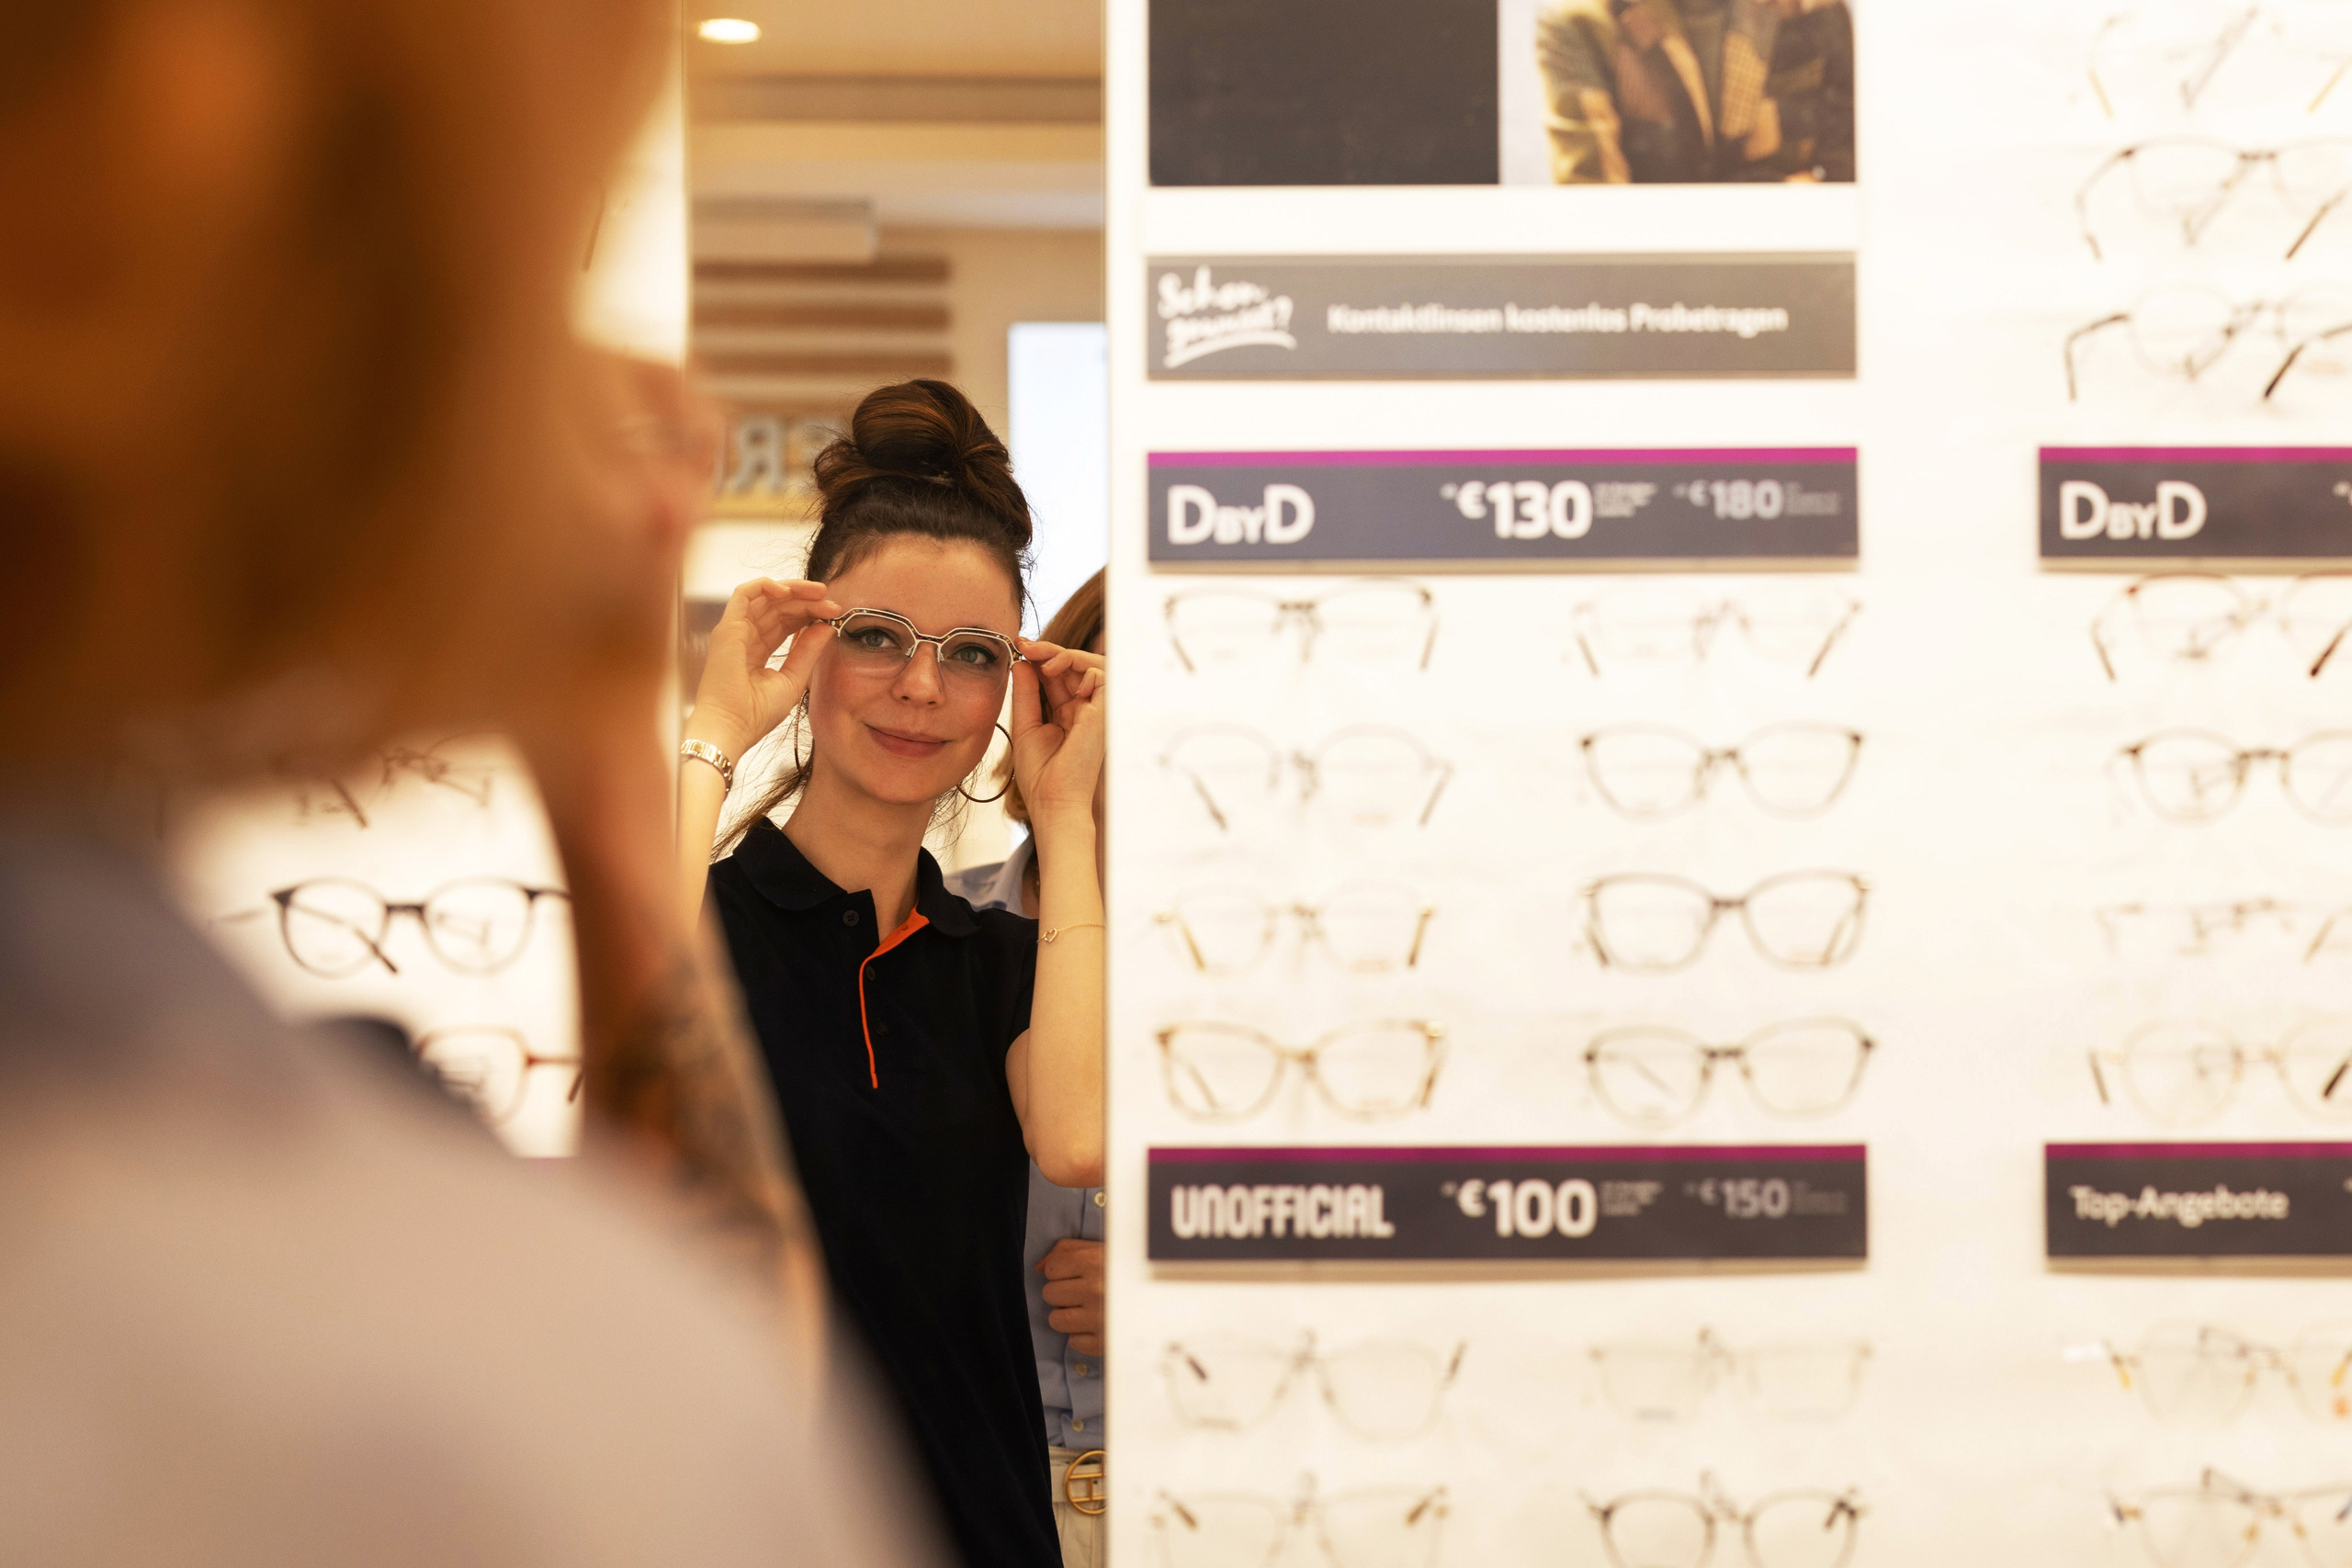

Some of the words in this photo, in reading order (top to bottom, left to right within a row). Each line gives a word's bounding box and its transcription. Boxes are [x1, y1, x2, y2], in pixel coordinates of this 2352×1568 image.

[1329, 303, 1503, 333] Kontaktlinsen
[1505, 303, 1627, 333] kostenlos
[1630, 302, 1788, 338] Probetragen
[1456, 479, 1593, 539] €130
[1170, 1183, 1395, 1238] UNOFFICIAL
[1457, 1178, 1597, 1237] €100
[2070, 1183, 2289, 1227] Top-Angebote
